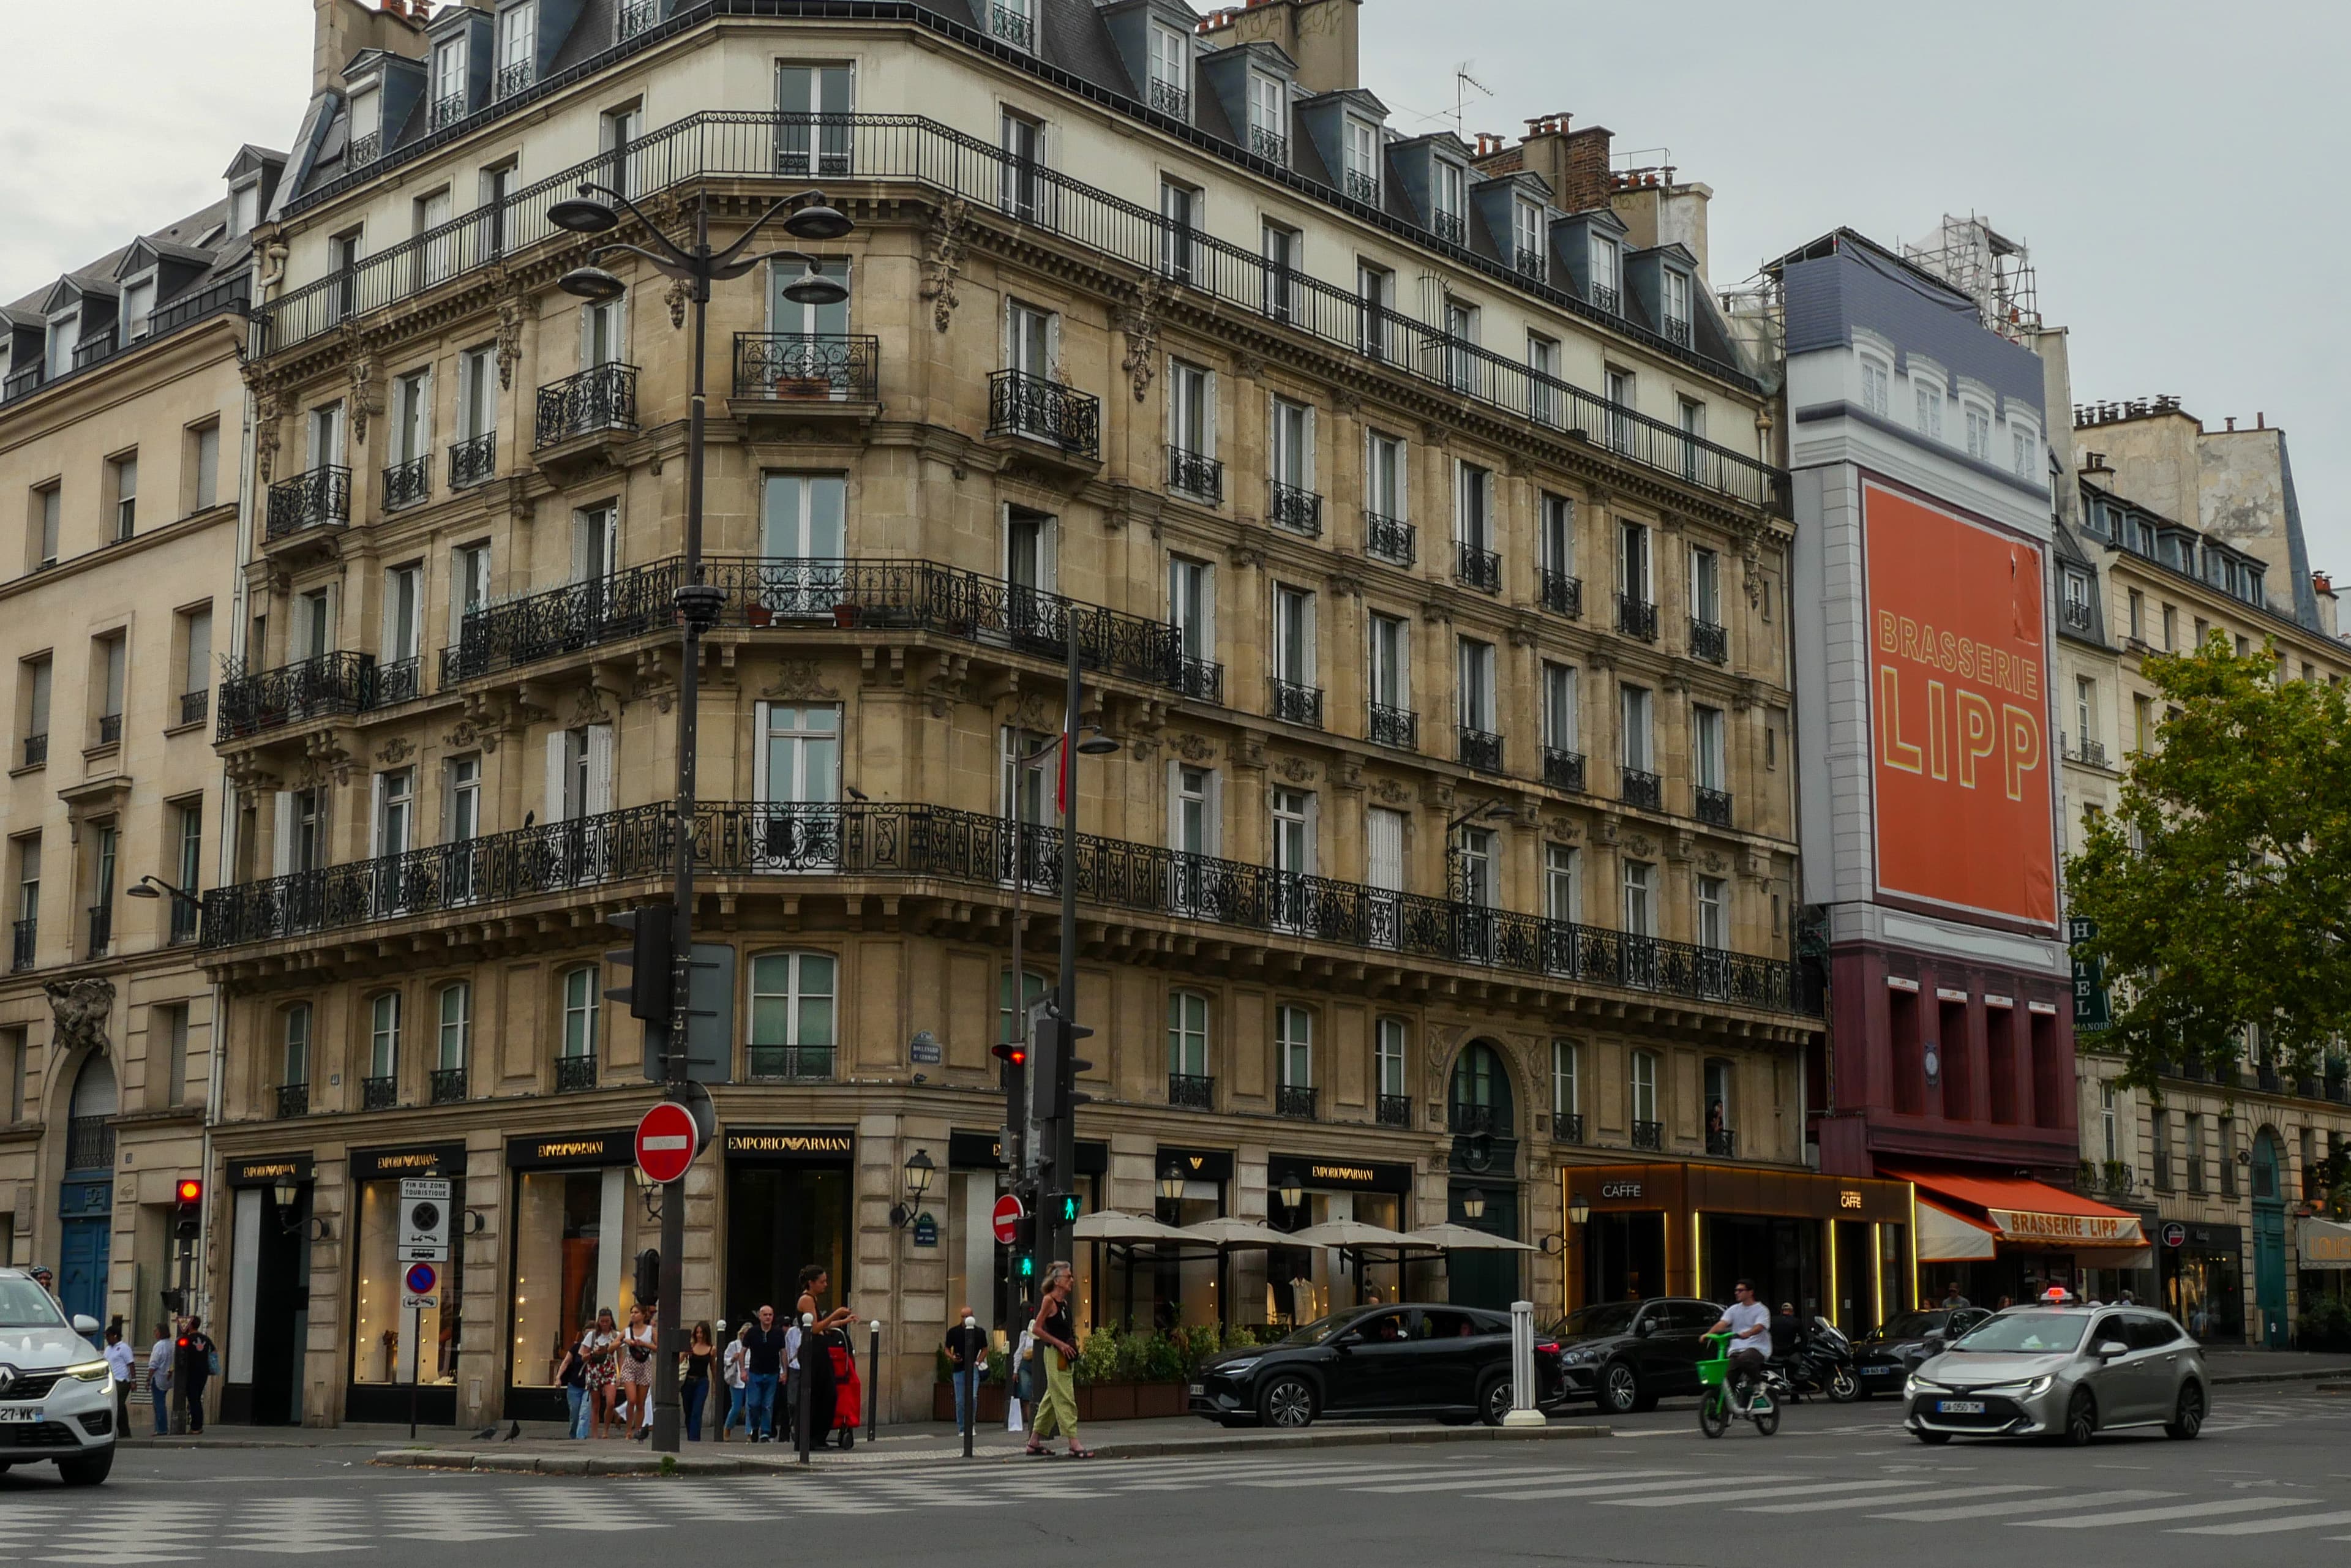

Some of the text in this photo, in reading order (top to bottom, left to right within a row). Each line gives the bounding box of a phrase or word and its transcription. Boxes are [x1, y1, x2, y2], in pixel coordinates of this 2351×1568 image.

[1878, 609, 2038, 700] BRASSERIE
[1881, 664, 2040, 801] LIPP
[728, 1137, 850, 1150] EMPORIO ARMANI
[1313, 1165, 1373, 1181] EMPORIO ARMANI
[2011, 1212, 2118, 1237] BRASSERIE LIPP
[1, 1408, 34, 1420] 27-WK
